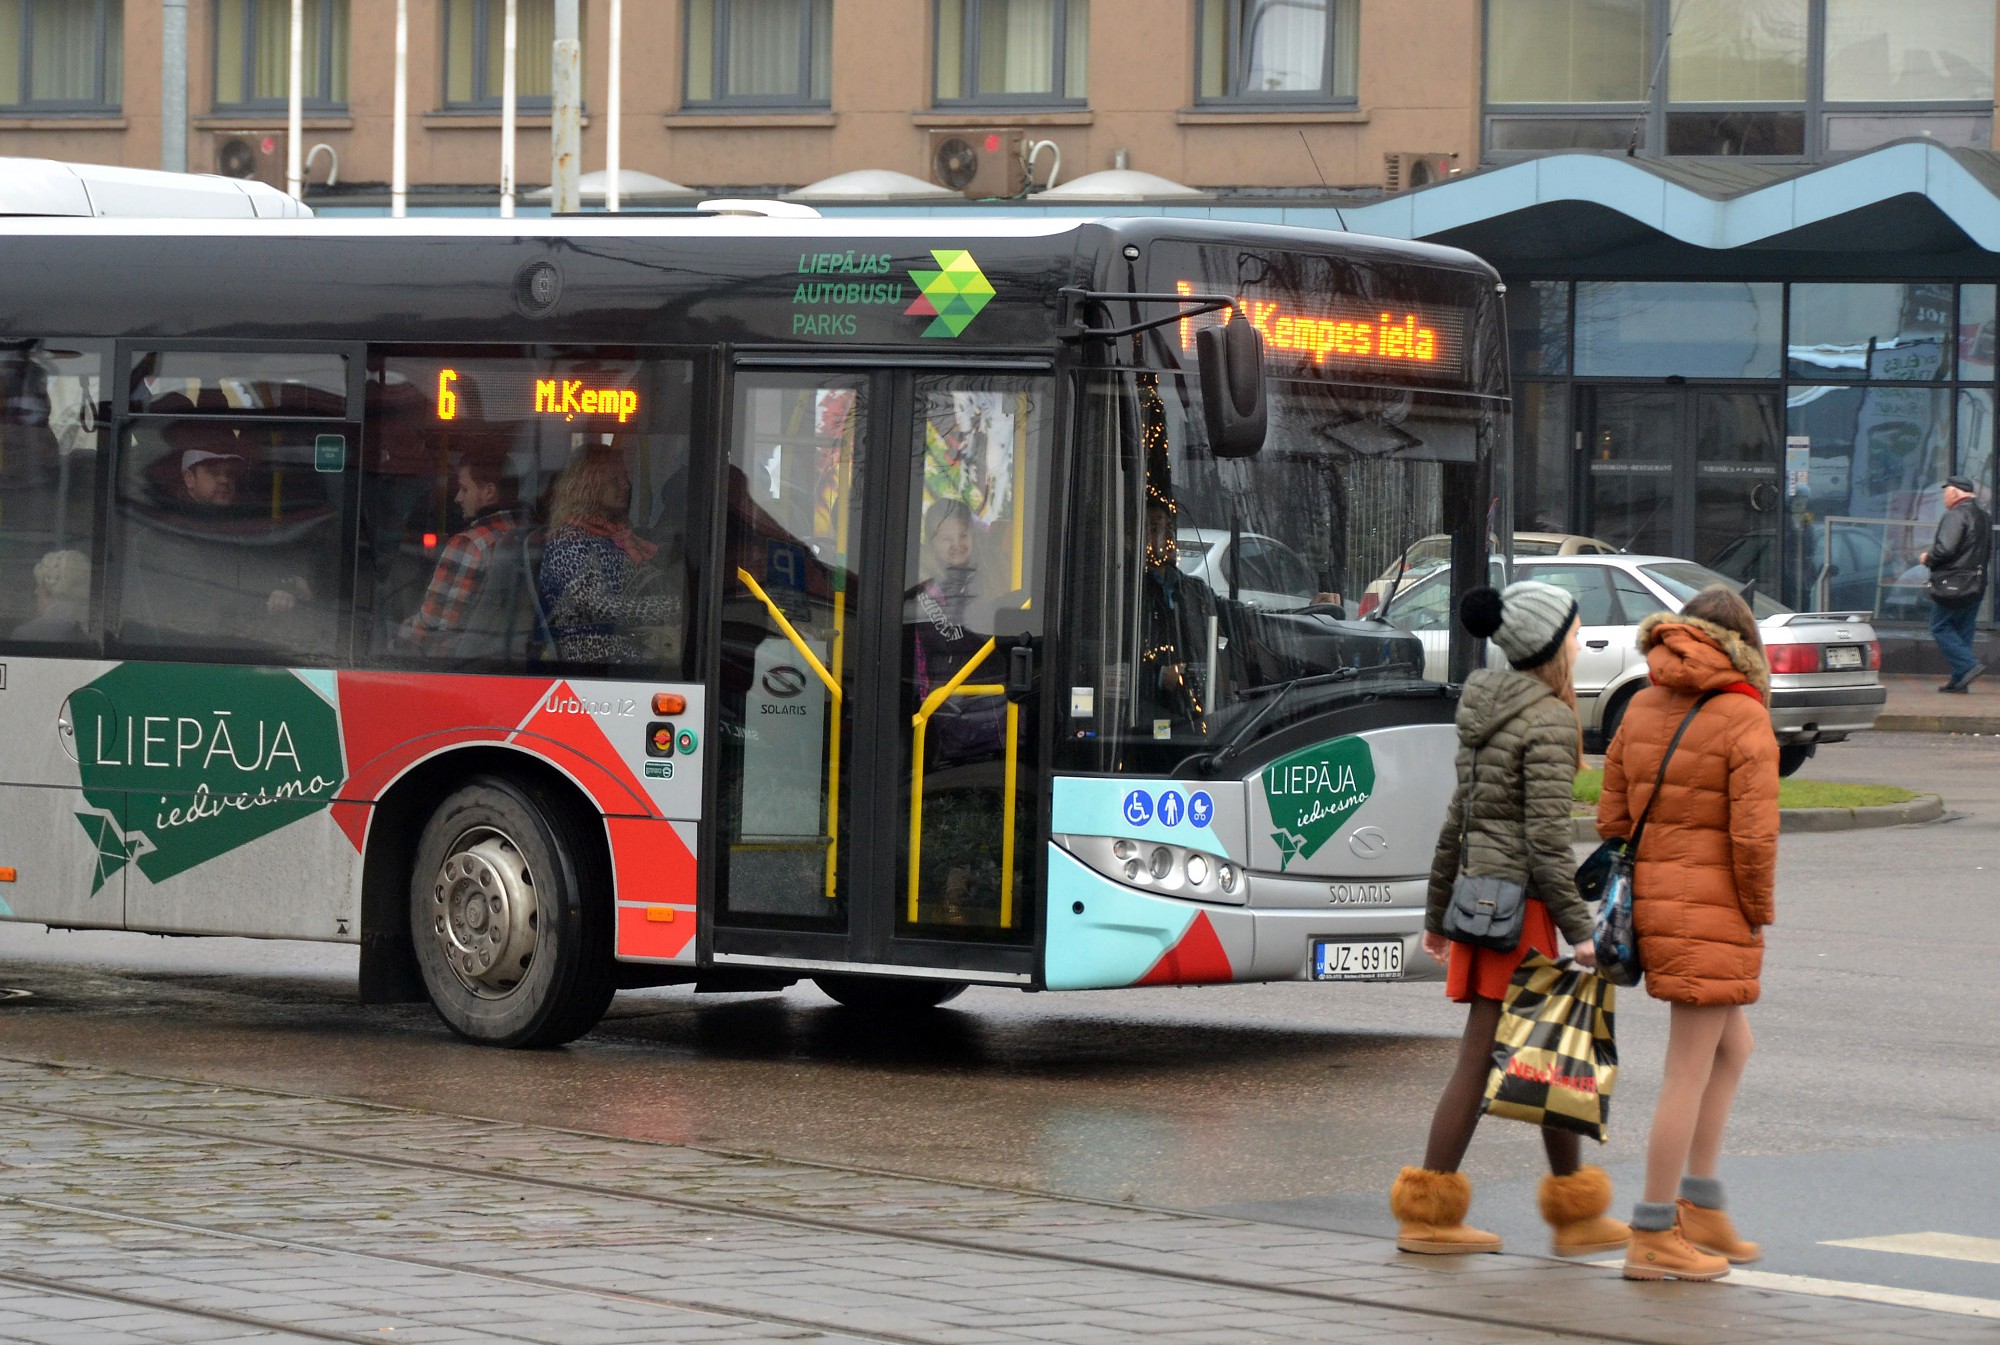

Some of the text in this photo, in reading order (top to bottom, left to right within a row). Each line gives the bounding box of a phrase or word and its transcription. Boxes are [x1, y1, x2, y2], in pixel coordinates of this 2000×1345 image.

[798, 251, 892, 274] LIEPĀJAS
[792, 283, 902, 305] AUTOBUSU
[793, 314, 857, 335] PARKS
[1379, 312, 1436, 360] iela
[437, 369, 457, 420] 6
[545, 695, 637, 717] Urbino 12
[761, 704, 807, 716] SOLARIS
[97, 711, 301, 772] LIEPĀJA
[1270, 761, 1357, 795] LIEPĀJA
[1329, 885, 1392, 904] SOLARIS
